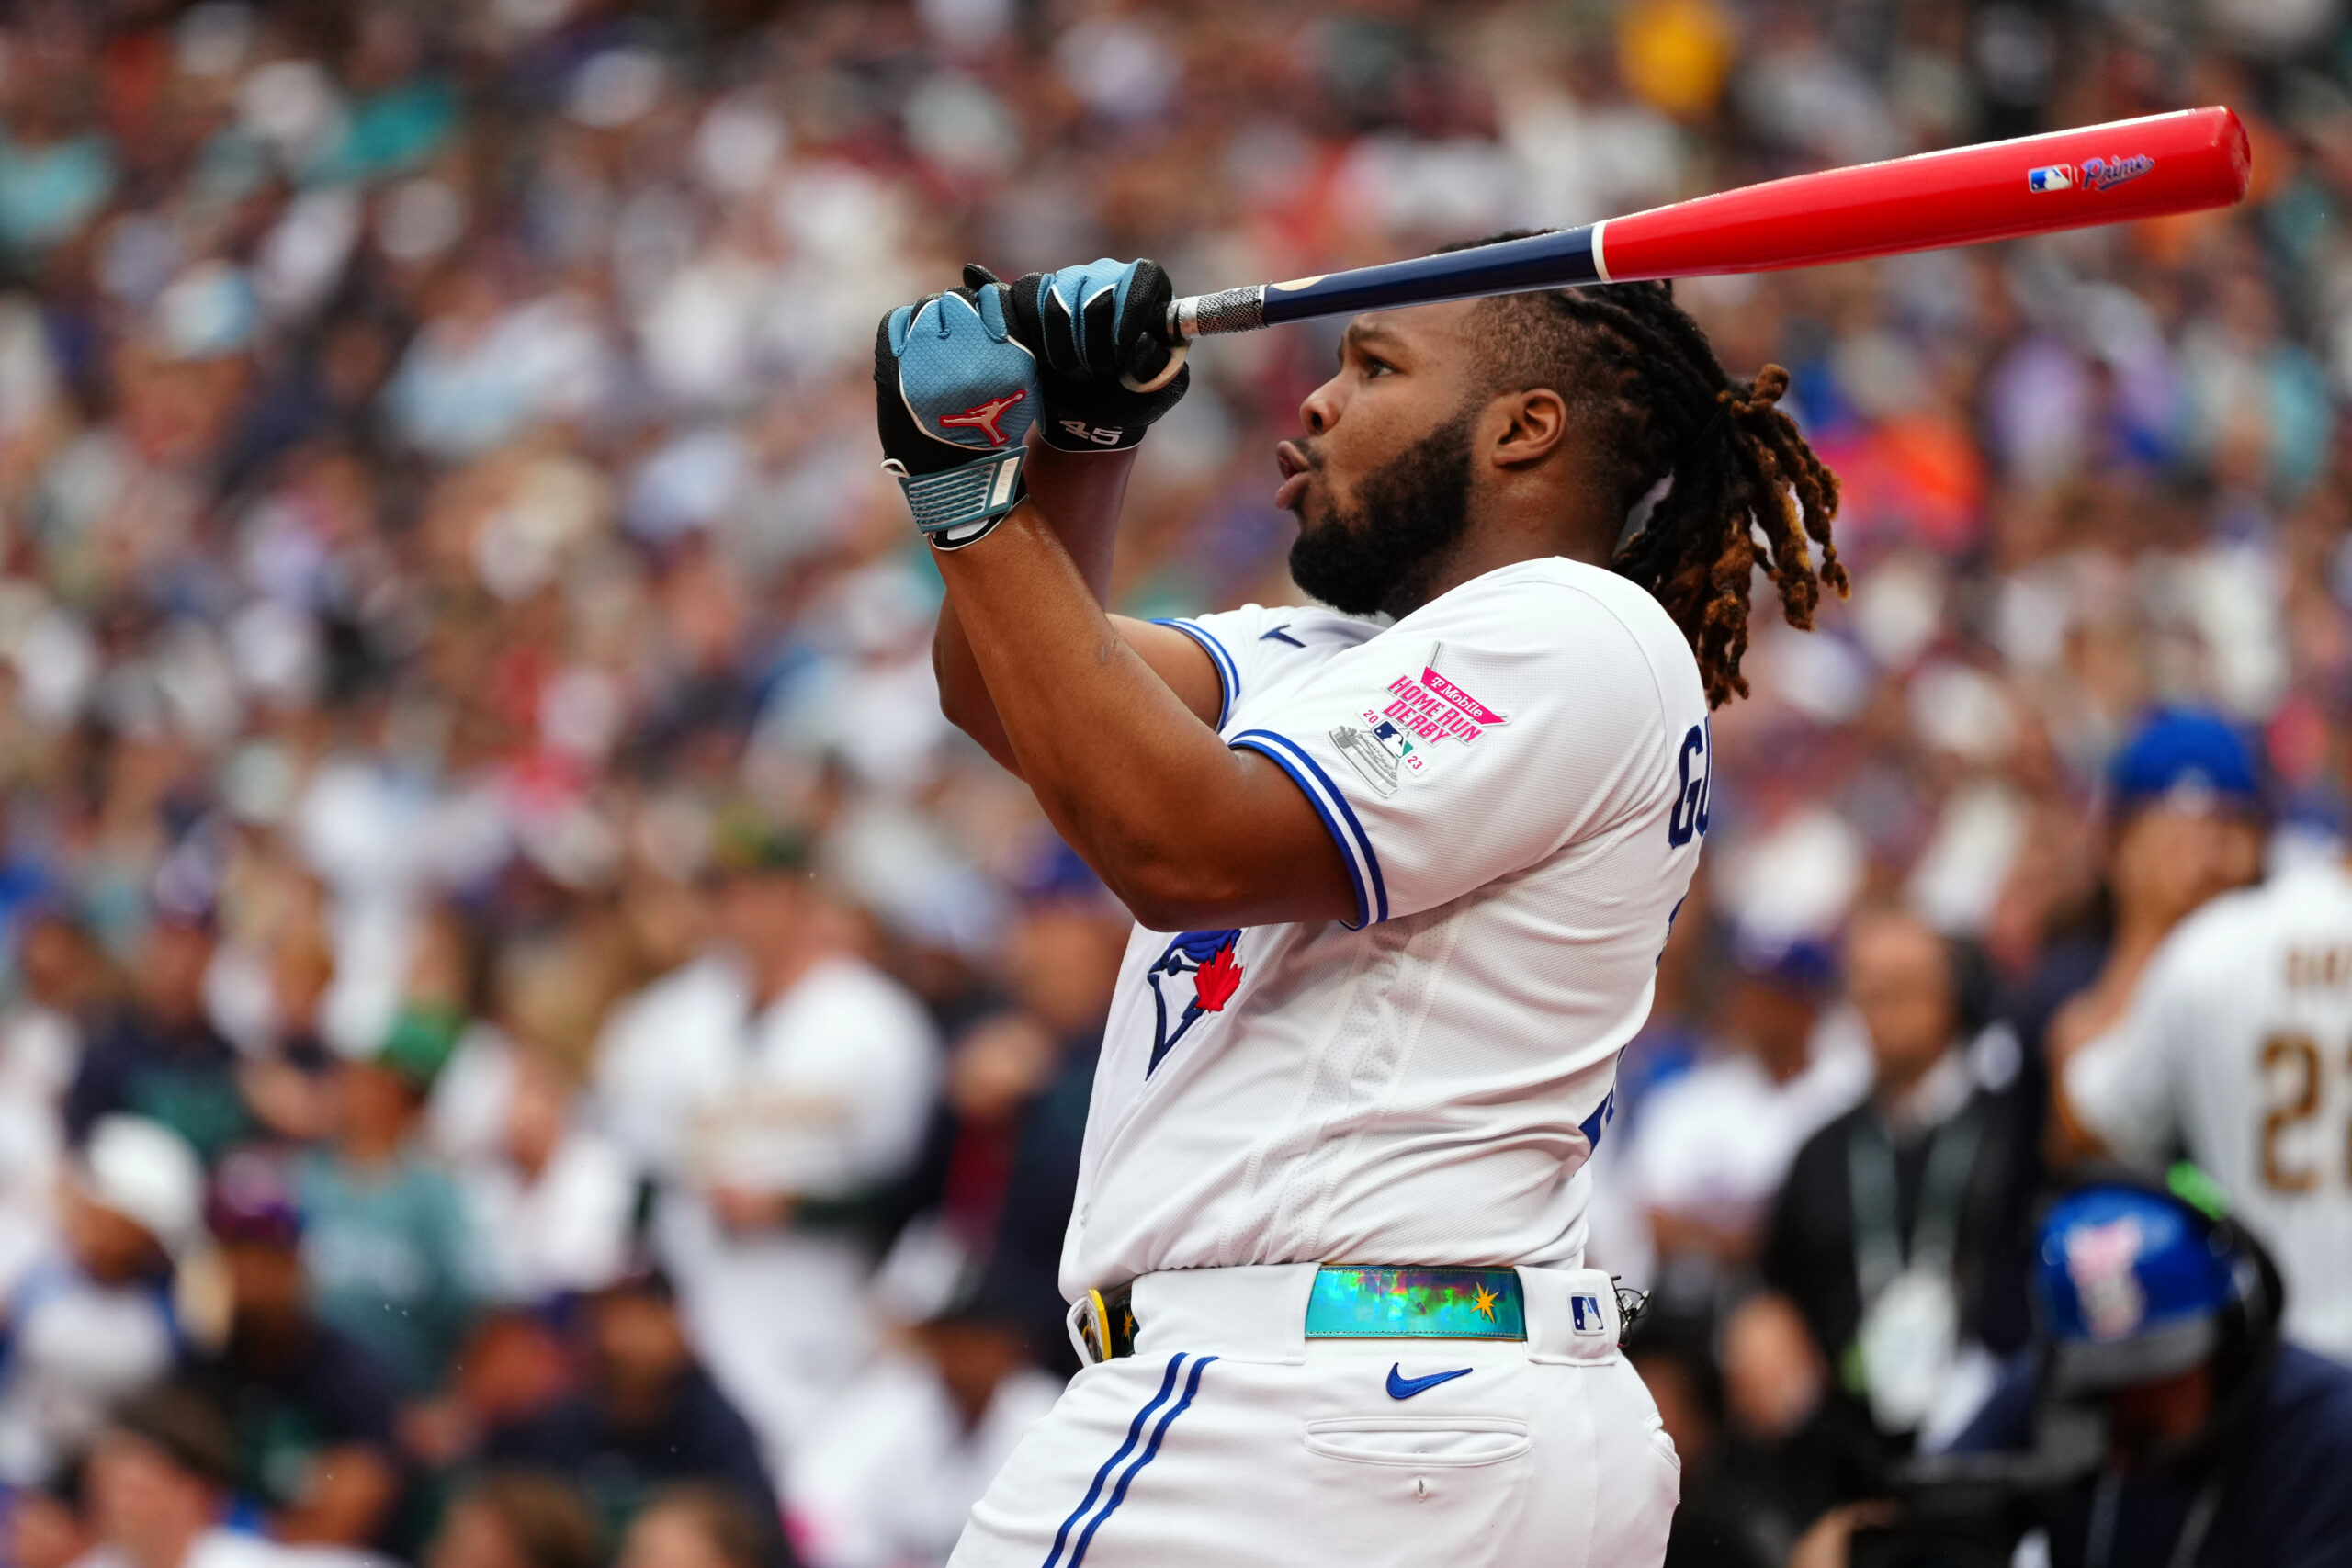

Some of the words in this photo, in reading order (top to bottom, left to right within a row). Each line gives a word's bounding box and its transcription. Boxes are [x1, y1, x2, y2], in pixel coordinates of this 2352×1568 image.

[2081, 154, 2154, 190] Prime
[1060, 421, 1123, 446] 45
[1363, 708, 1379, 724] 20
[1383, 699, 1451, 745] DERBY
[1388, 675, 1446, 720] HOME
[1436, 707, 1483, 744] RUN
[1407, 755, 1423, 770] 23
[2262, 1035, 2352, 1191] 2
